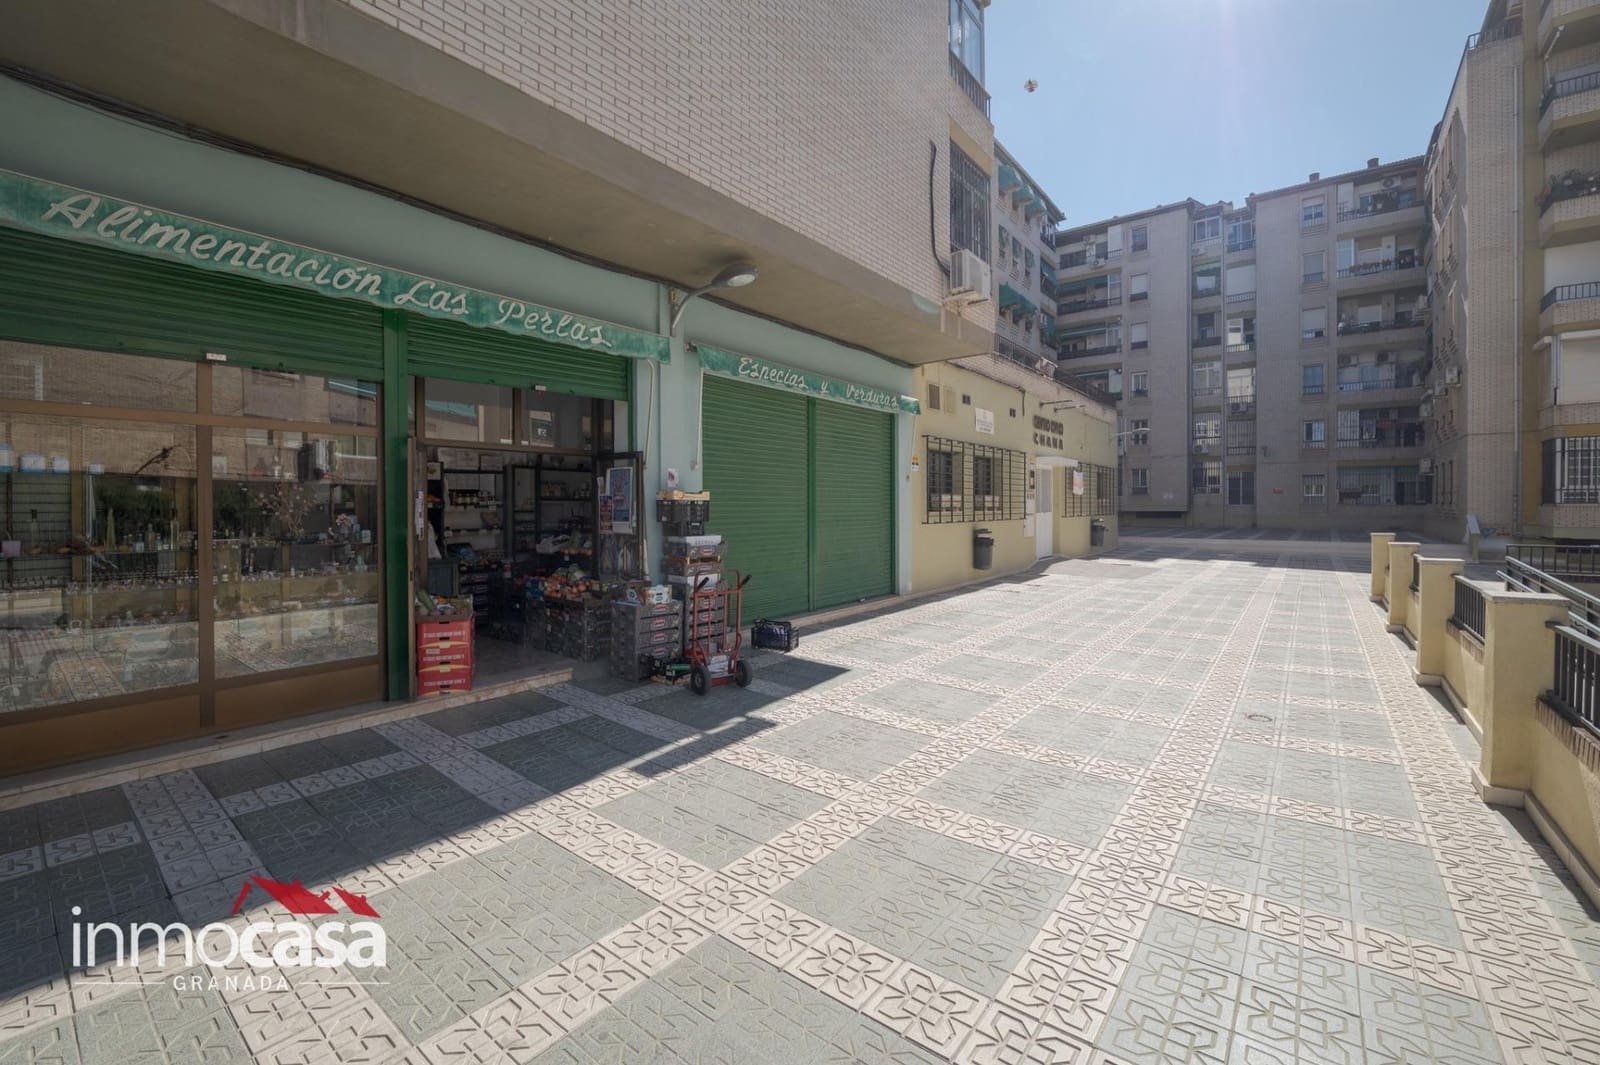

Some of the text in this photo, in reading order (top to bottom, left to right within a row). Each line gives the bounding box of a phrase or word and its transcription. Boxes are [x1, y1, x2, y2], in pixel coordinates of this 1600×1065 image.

[394, 280, 469, 315] Las
[496, 299, 613, 348] Perlas
[738, 356, 809, 389] Especias
[846, 383, 899, 407] Verduras
[1033, 432, 1063, 449] CHANA
